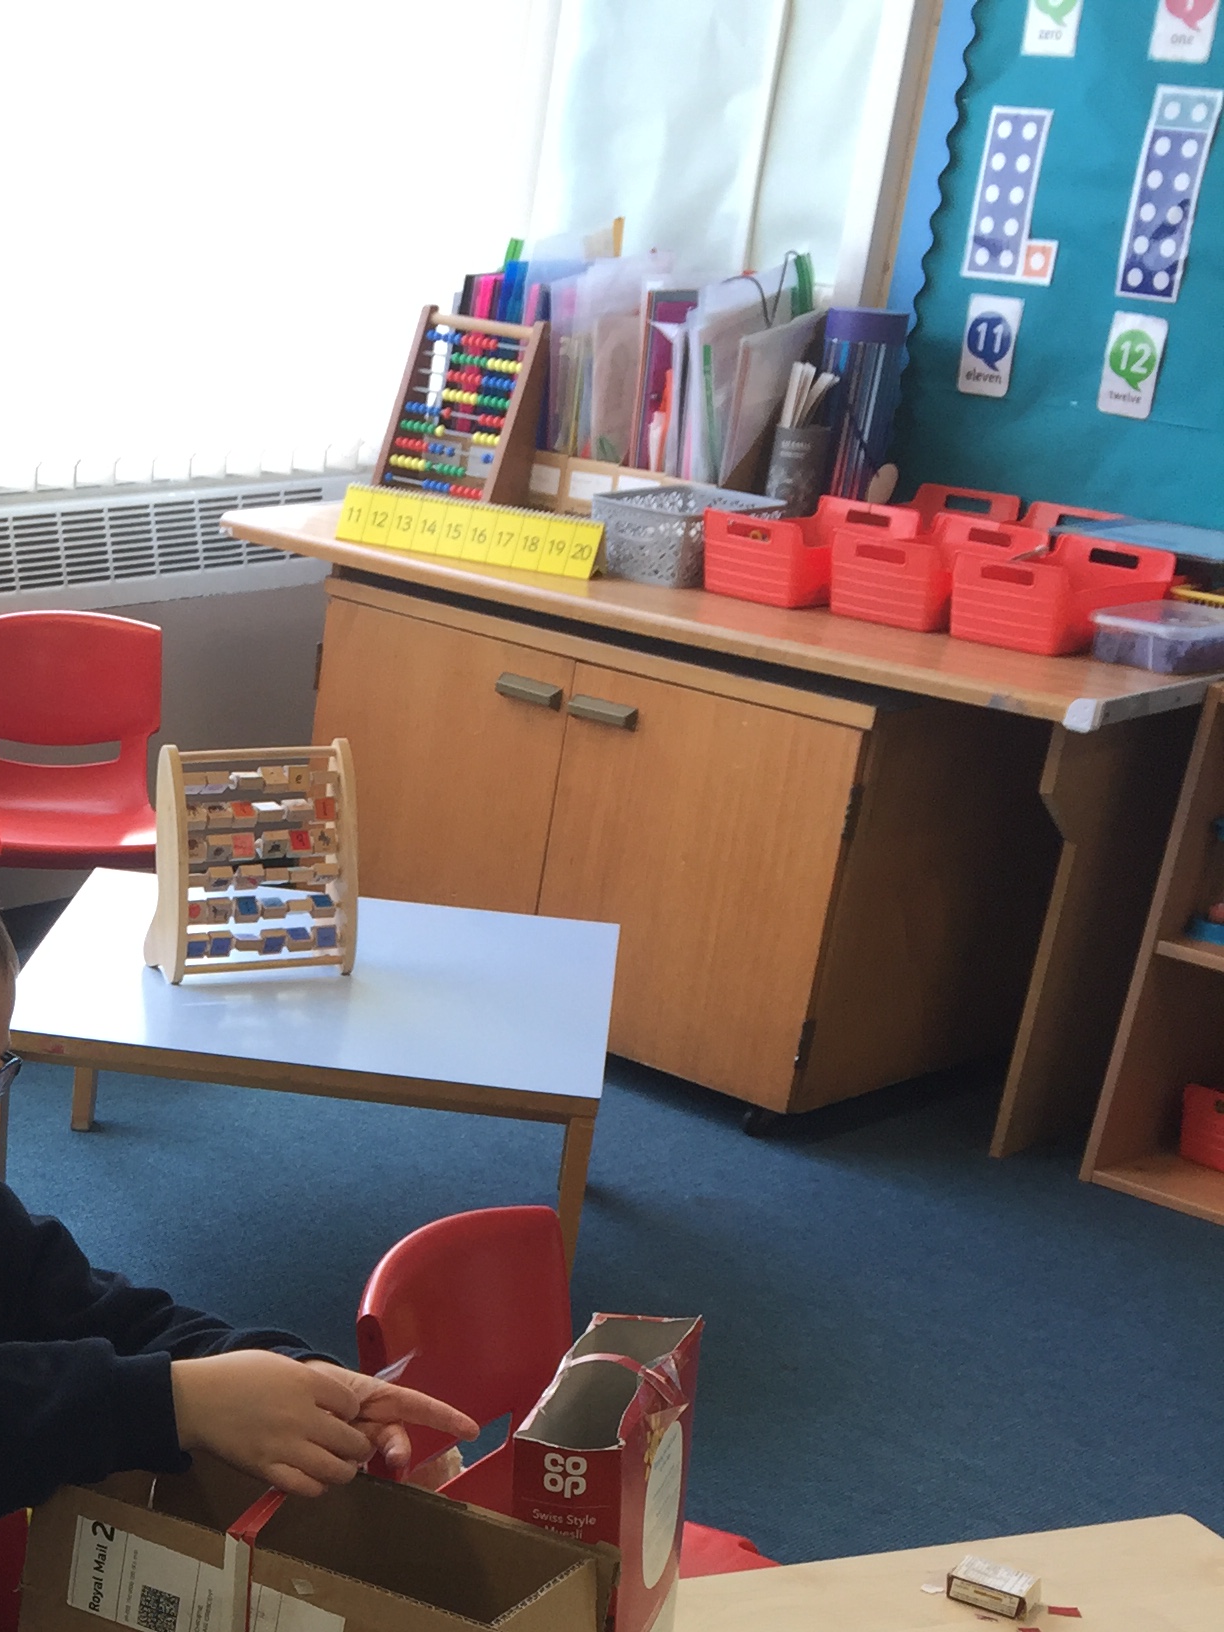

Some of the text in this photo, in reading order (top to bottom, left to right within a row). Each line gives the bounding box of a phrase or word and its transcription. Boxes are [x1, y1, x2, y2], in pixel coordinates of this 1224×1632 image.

[1038, 29, 1063, 41] zero
[1170, 33, 1195, 45] one
[975, 322, 1005, 354] 11
[1119, 341, 1153, 374] 12
[965, 369, 1002, 385] eleven
[1109, 390, 1143, 404] twelve
[346, 506, 593, 562] 11 12 13 14 15 16 17 18 19 20
[532, 1508, 597, 1528] Swiss Style
[88, 1520, 116, 1612] Royal Mail 2
